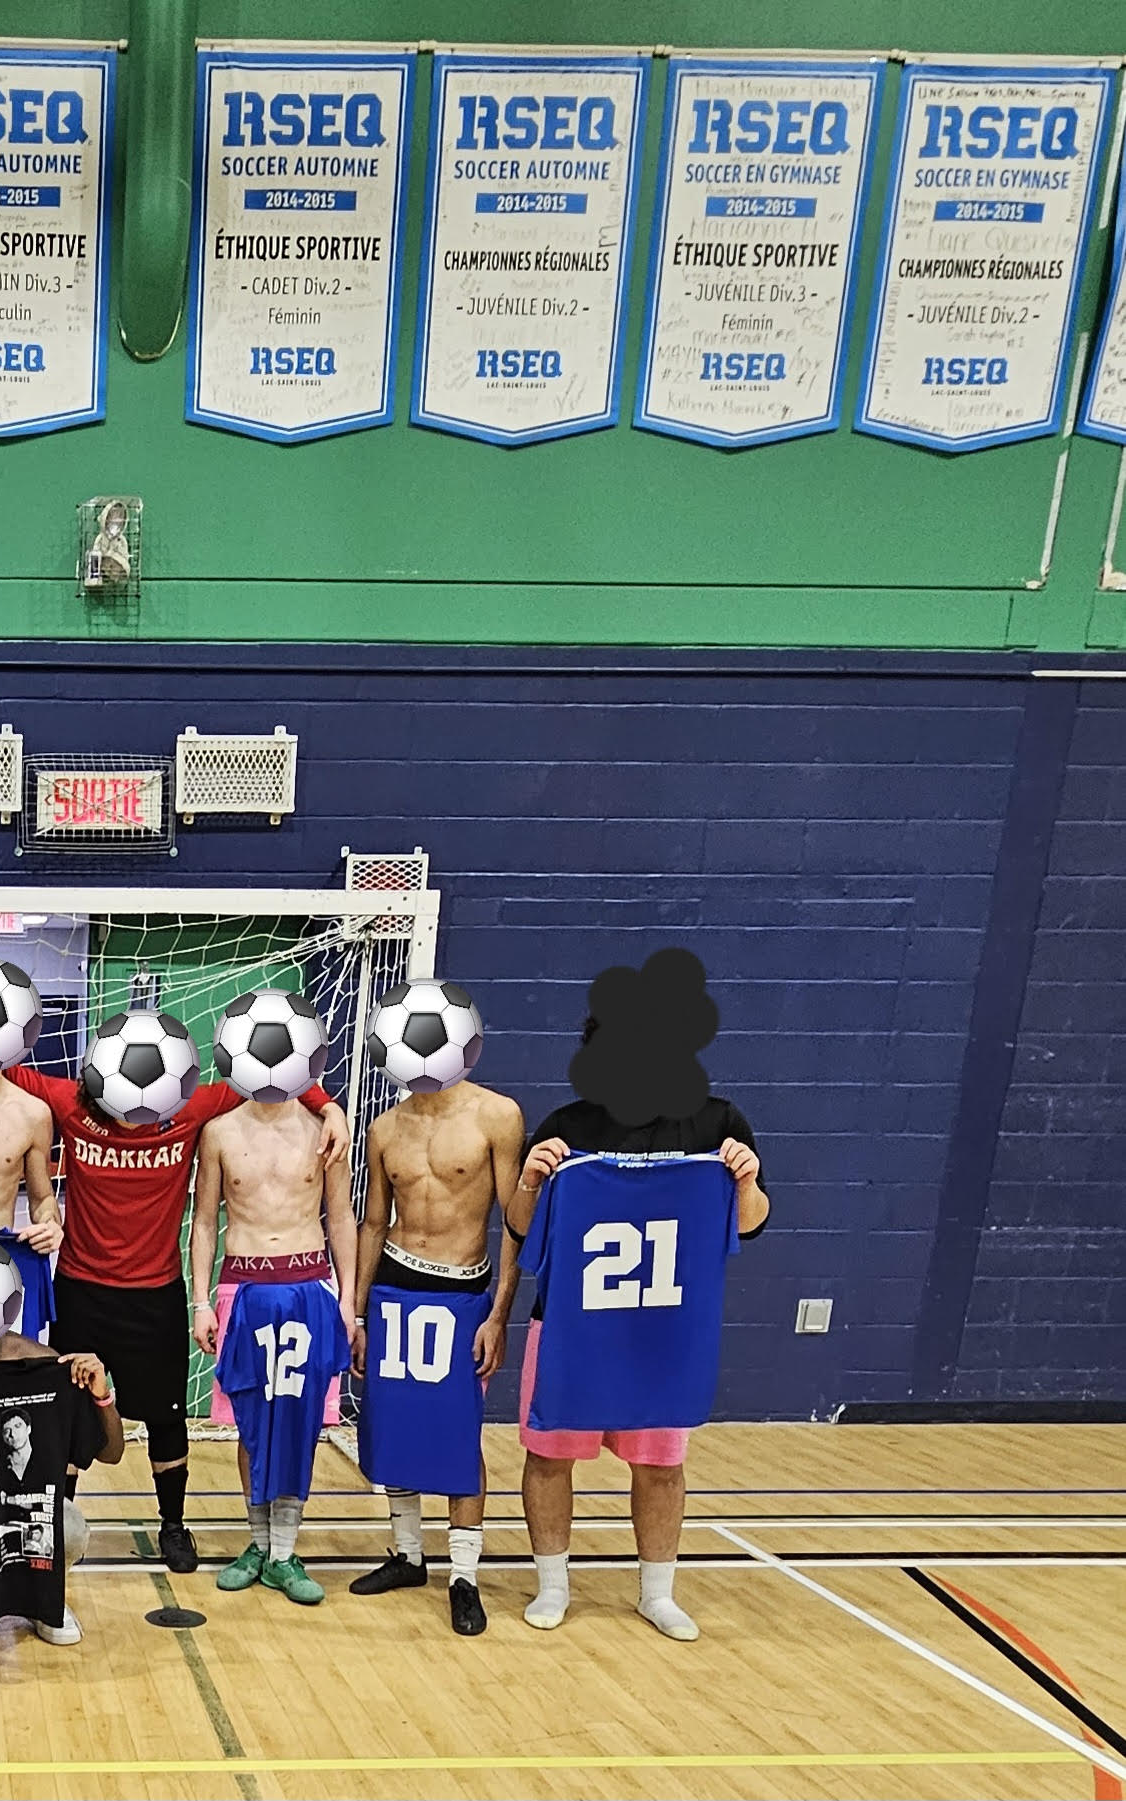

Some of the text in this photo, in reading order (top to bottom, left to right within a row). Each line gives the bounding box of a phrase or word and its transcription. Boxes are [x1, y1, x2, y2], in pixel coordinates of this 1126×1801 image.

[223, 92, 386, 147] RSEQ
[456, 96, 618, 150] RSEQ
[688, 100, 850, 155] RSEQ
[919, 105, 1079, 160] RSEQ
[222, 156, 378, 177] SOCCER AUTOMNE
[454, 160, 610, 180] SOCCER AUTOMNE
[685, 164, 841, 184] SOCCER EN GYMNASE
[914, 168, 1070, 190] SOCCER EN GYMNASE
[266, 192, 335, 208] 2014-2015
[497, 195, 566, 211] 2014-2015
[727, 199, 795, 215] 2014-2015
[956, 203, 1023, 219] 2014-2015
[0, 232, 86, 258] SPORTIVE
[215, 228, 381, 261] ÉTHIQUE SPORTIVE
[673, 235, 839, 268] ÉTHIQUE SPORTIVE
[445, 245, 609, 271] CHAMPIONNES RÉGIONALES
[899, 254, 1063, 280] CHAMPIONNES RÉGIONALES
[26, 274, 60, 293] Div.3
[252, 277, 298, 295] CADET
[304, 277, 340, 295] Div.2
[695, 283, 765, 302] JUVÉNILE
[770, 284, 805, 302] Div.3
[269, 307, 320, 324] Féminin
[467, 297, 537, 315] JUVÉNILE
[543, 298, 578, 316] Div.2
[918, 301, 987, 324] JUVÉNILE
[991, 306, 1028, 324] Div.2
[722, 314, 773, 330] Féminin
[250, 347, 337, 375] RSEQ
[476, 350, 562, 377] RSEQ
[700, 353, 786, 380] RSEQ
[922, 358, 1008, 385] RSEQ
[54, 778, 144, 825] SORTIE
[74, 1138, 184, 1168] DRAKKAR
[231, 1252, 325, 1270] AKA AKA
[418, 1260, 450, 1274] BOXER
[582, 1220, 682, 1310] 21
[379, 1302, 456, 1384] 10
[254, 1322, 313, 1401] 12
